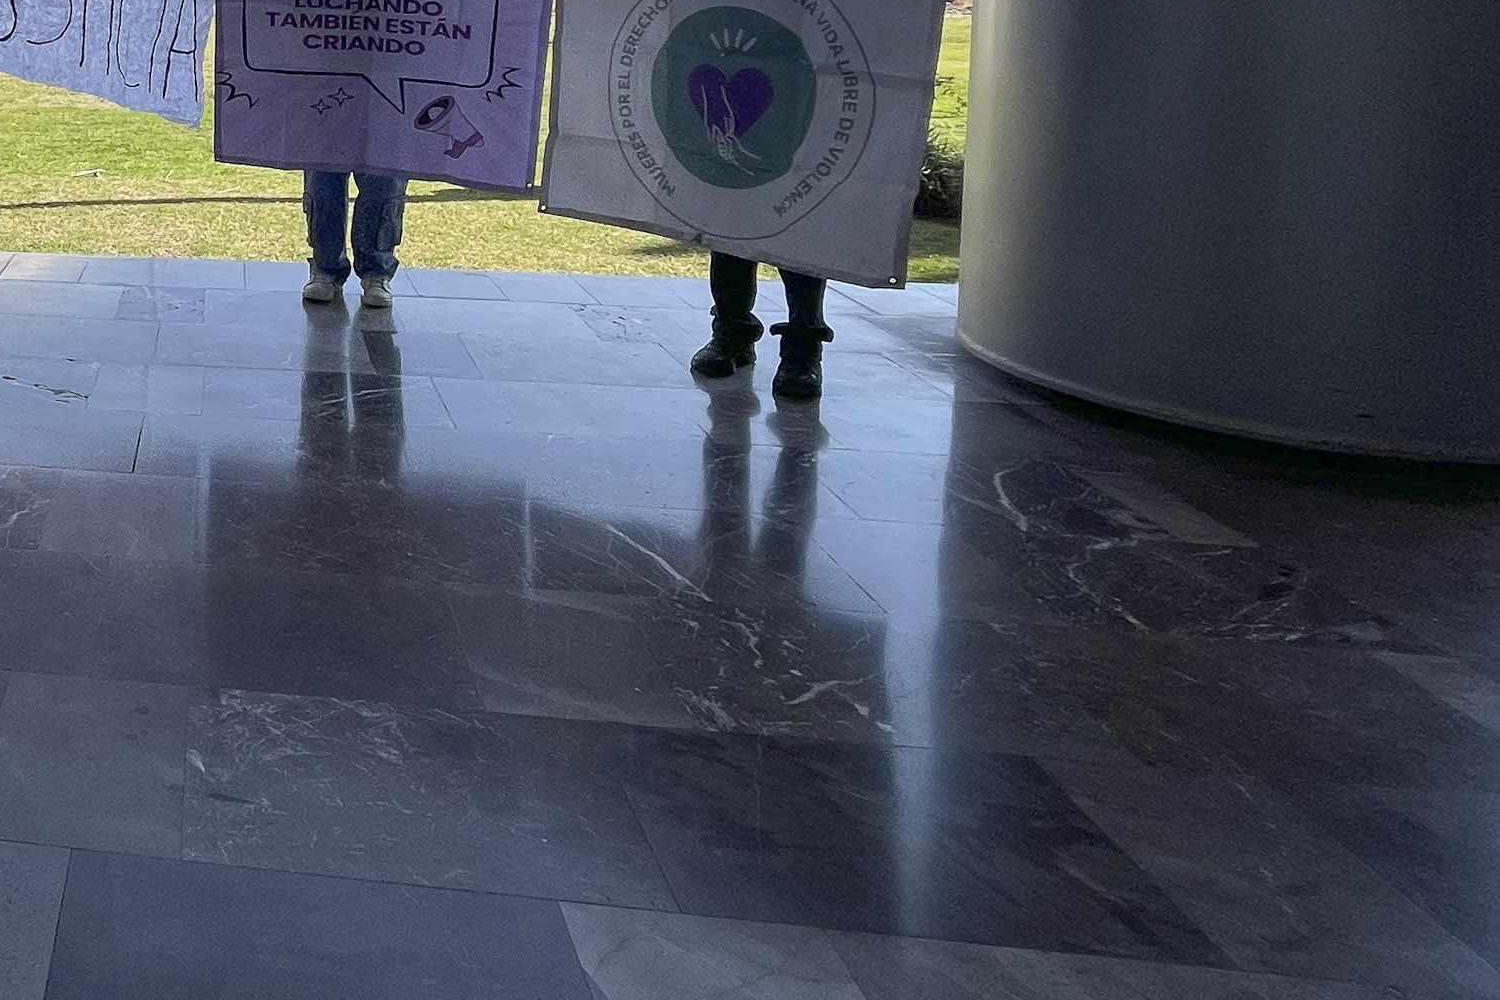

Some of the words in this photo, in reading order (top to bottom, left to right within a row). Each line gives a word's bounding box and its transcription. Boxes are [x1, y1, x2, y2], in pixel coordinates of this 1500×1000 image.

[386, 18, 471, 40] ESTÁN
[817, 12, 845, 57] VIDA
[303, 34, 425, 56] CRIANDO
[618, 70, 630, 89] EL
[836, 59, 859, 113] LIBRE
[618, 94, 635, 128] POR
[834, 117, 855, 144] DE
[628, 131, 676, 197] MUJERES
